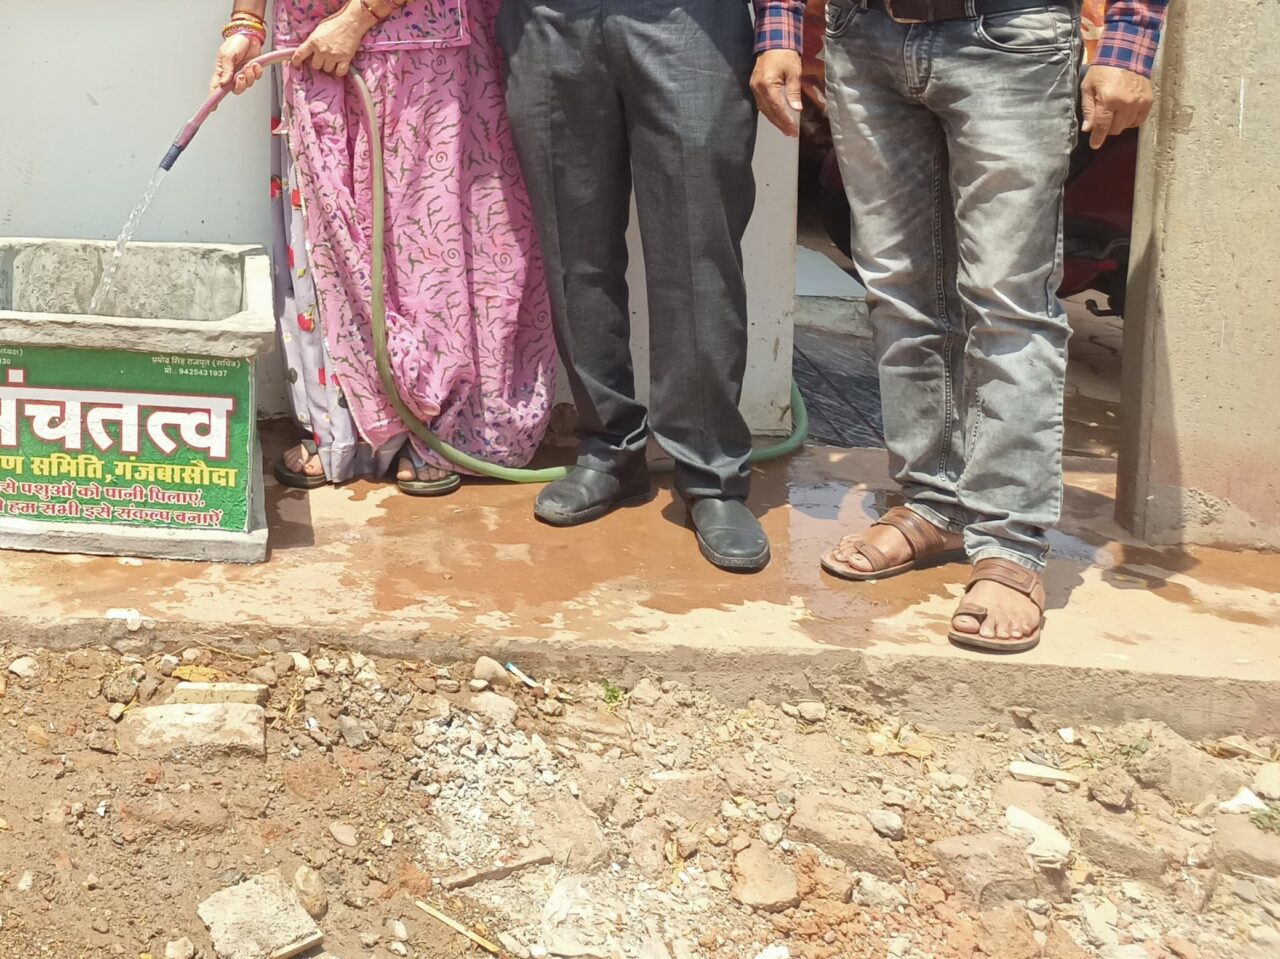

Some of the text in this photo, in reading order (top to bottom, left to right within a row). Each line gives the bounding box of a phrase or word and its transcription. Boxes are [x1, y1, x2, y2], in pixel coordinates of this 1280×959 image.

[20, 480, 76, 500] पशुओं
[76, 480, 101, 500] को
[104, 483, 145, 502] पानी
[7, 501, 37, 515] हम
[38, 500, 81, 517] सभी
[81, 502, 112, 520] इसे
[114, 503, 173, 523] संकल्प
